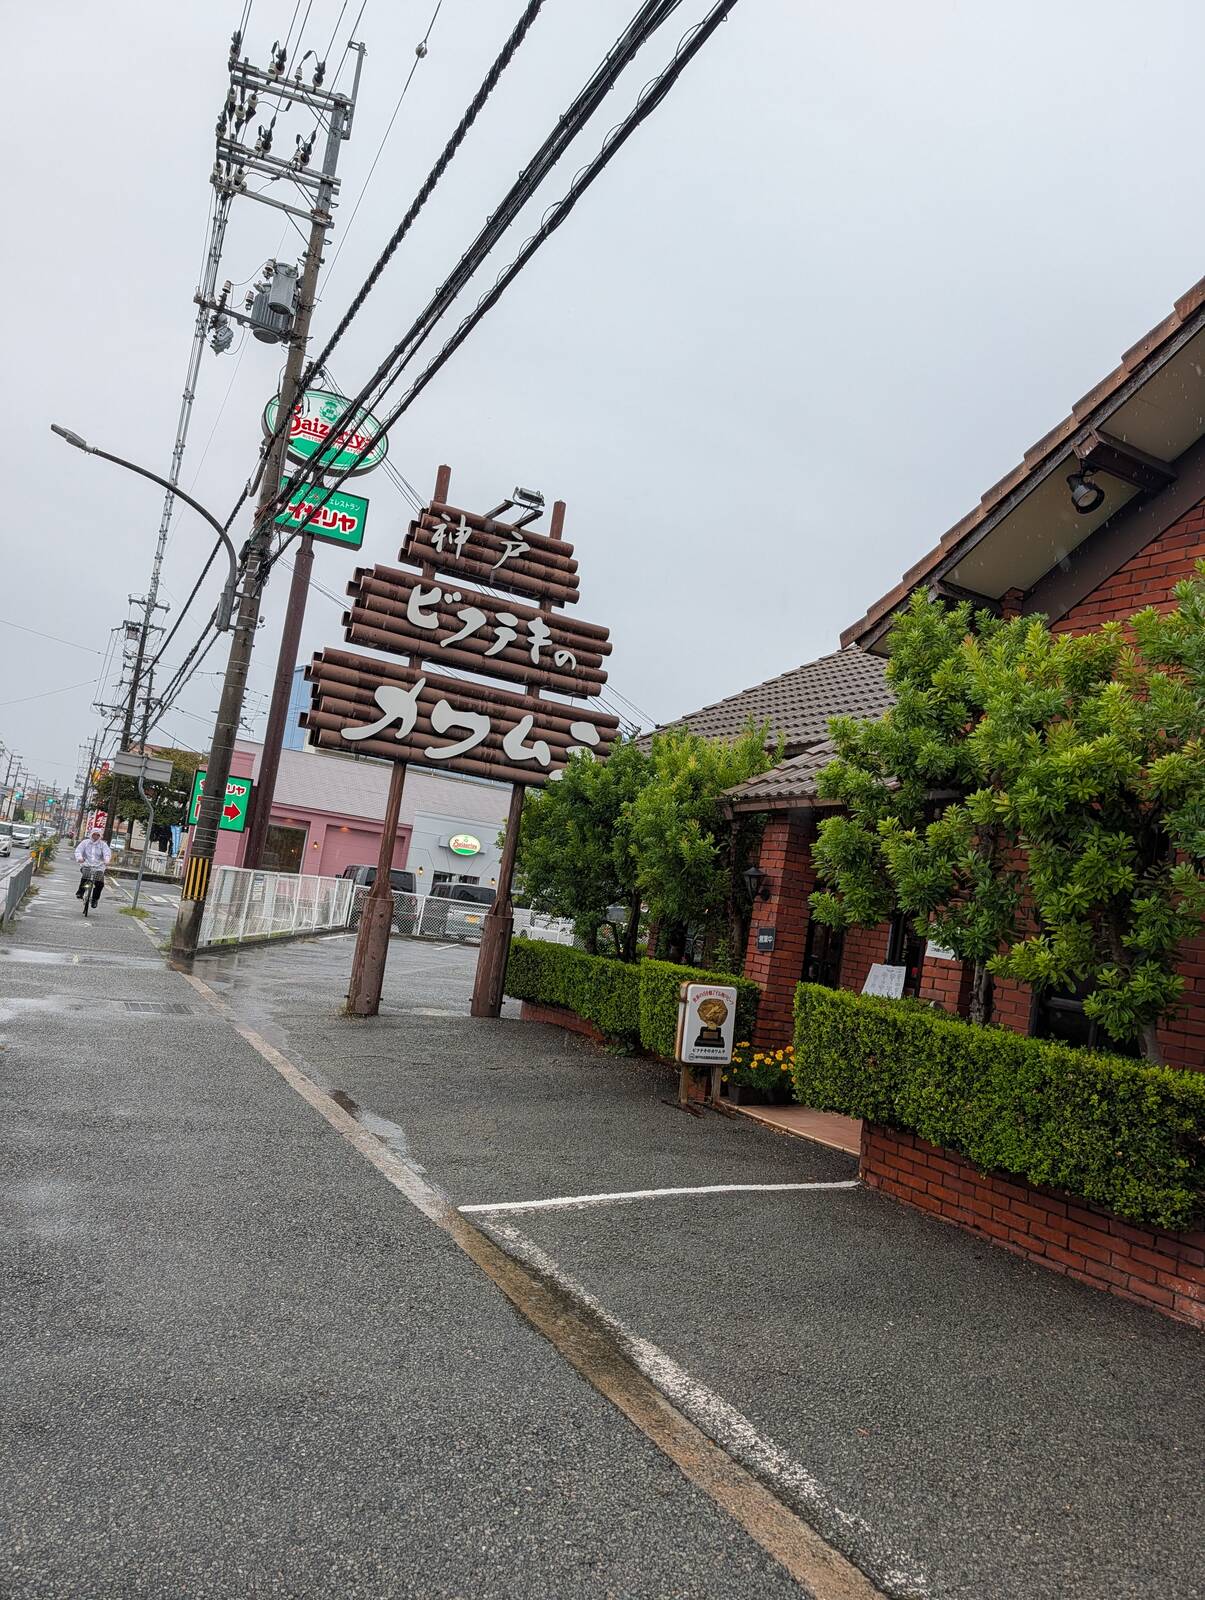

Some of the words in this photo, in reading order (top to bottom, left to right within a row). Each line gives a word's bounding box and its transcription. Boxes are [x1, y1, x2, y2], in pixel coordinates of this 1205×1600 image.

[282, 501, 357, 534] イゼリヤ
[430, 514, 530, 570] 神戸
[407, 584, 577, 670] ビフテキの
